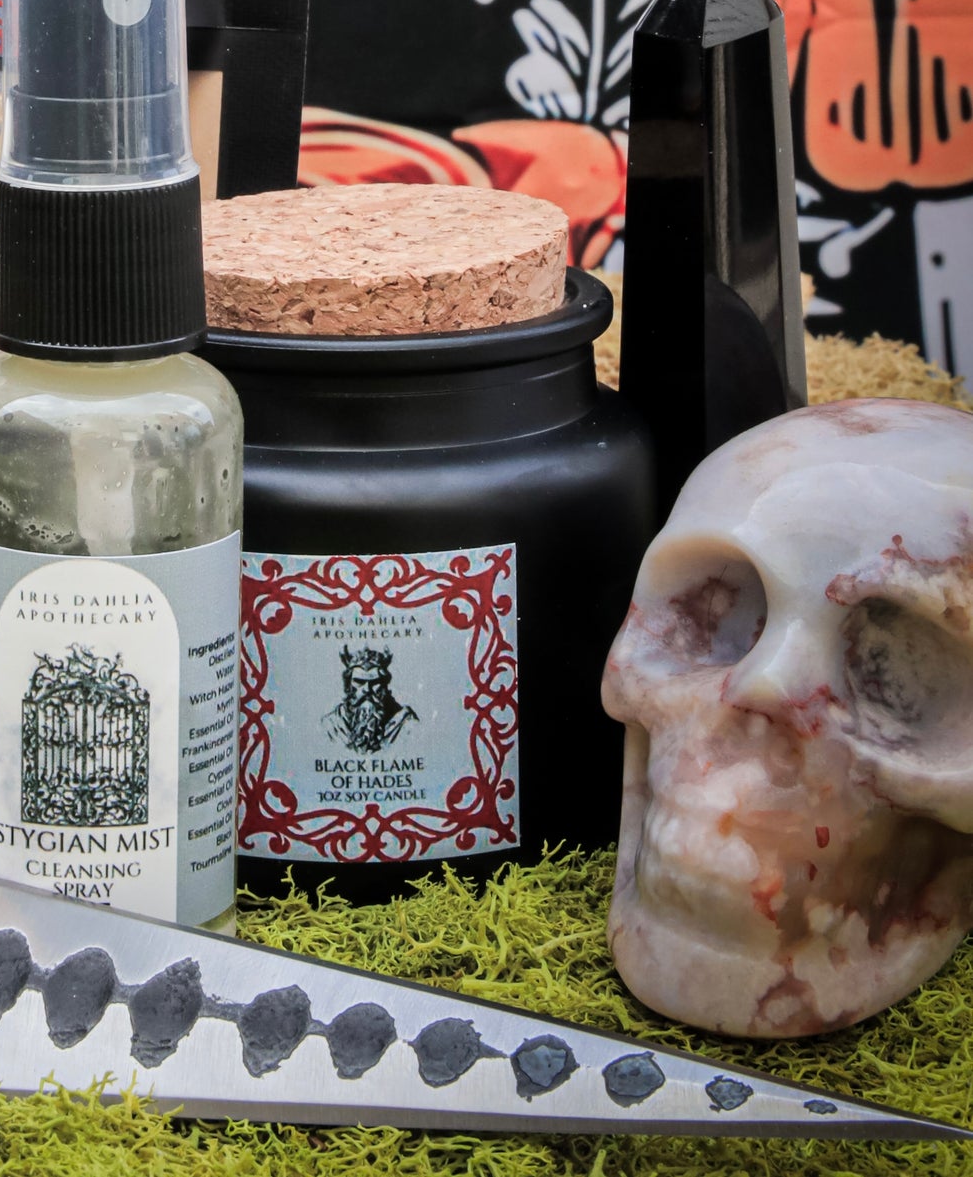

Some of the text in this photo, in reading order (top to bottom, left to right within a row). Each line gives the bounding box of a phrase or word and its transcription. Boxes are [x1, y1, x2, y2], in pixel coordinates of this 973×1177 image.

[20, 590, 154, 607] IRIS DAHLIA
[16, 608, 157, 624] APOTHECARY
[355, 615, 417, 626] DAHLIA
[313, 628, 423, 639] APOTHECARY
[315, 757, 424, 772] BLACK FLAME
[331, 774, 412, 789] OF HADES
[346, 792, 370, 802] SOY
[374, 789, 426, 801] CANDLE
[117, 826, 175, 852] MIST
[26, 859, 141, 879] CLEANSING
[53, 882, 114, 898] SPRAY
